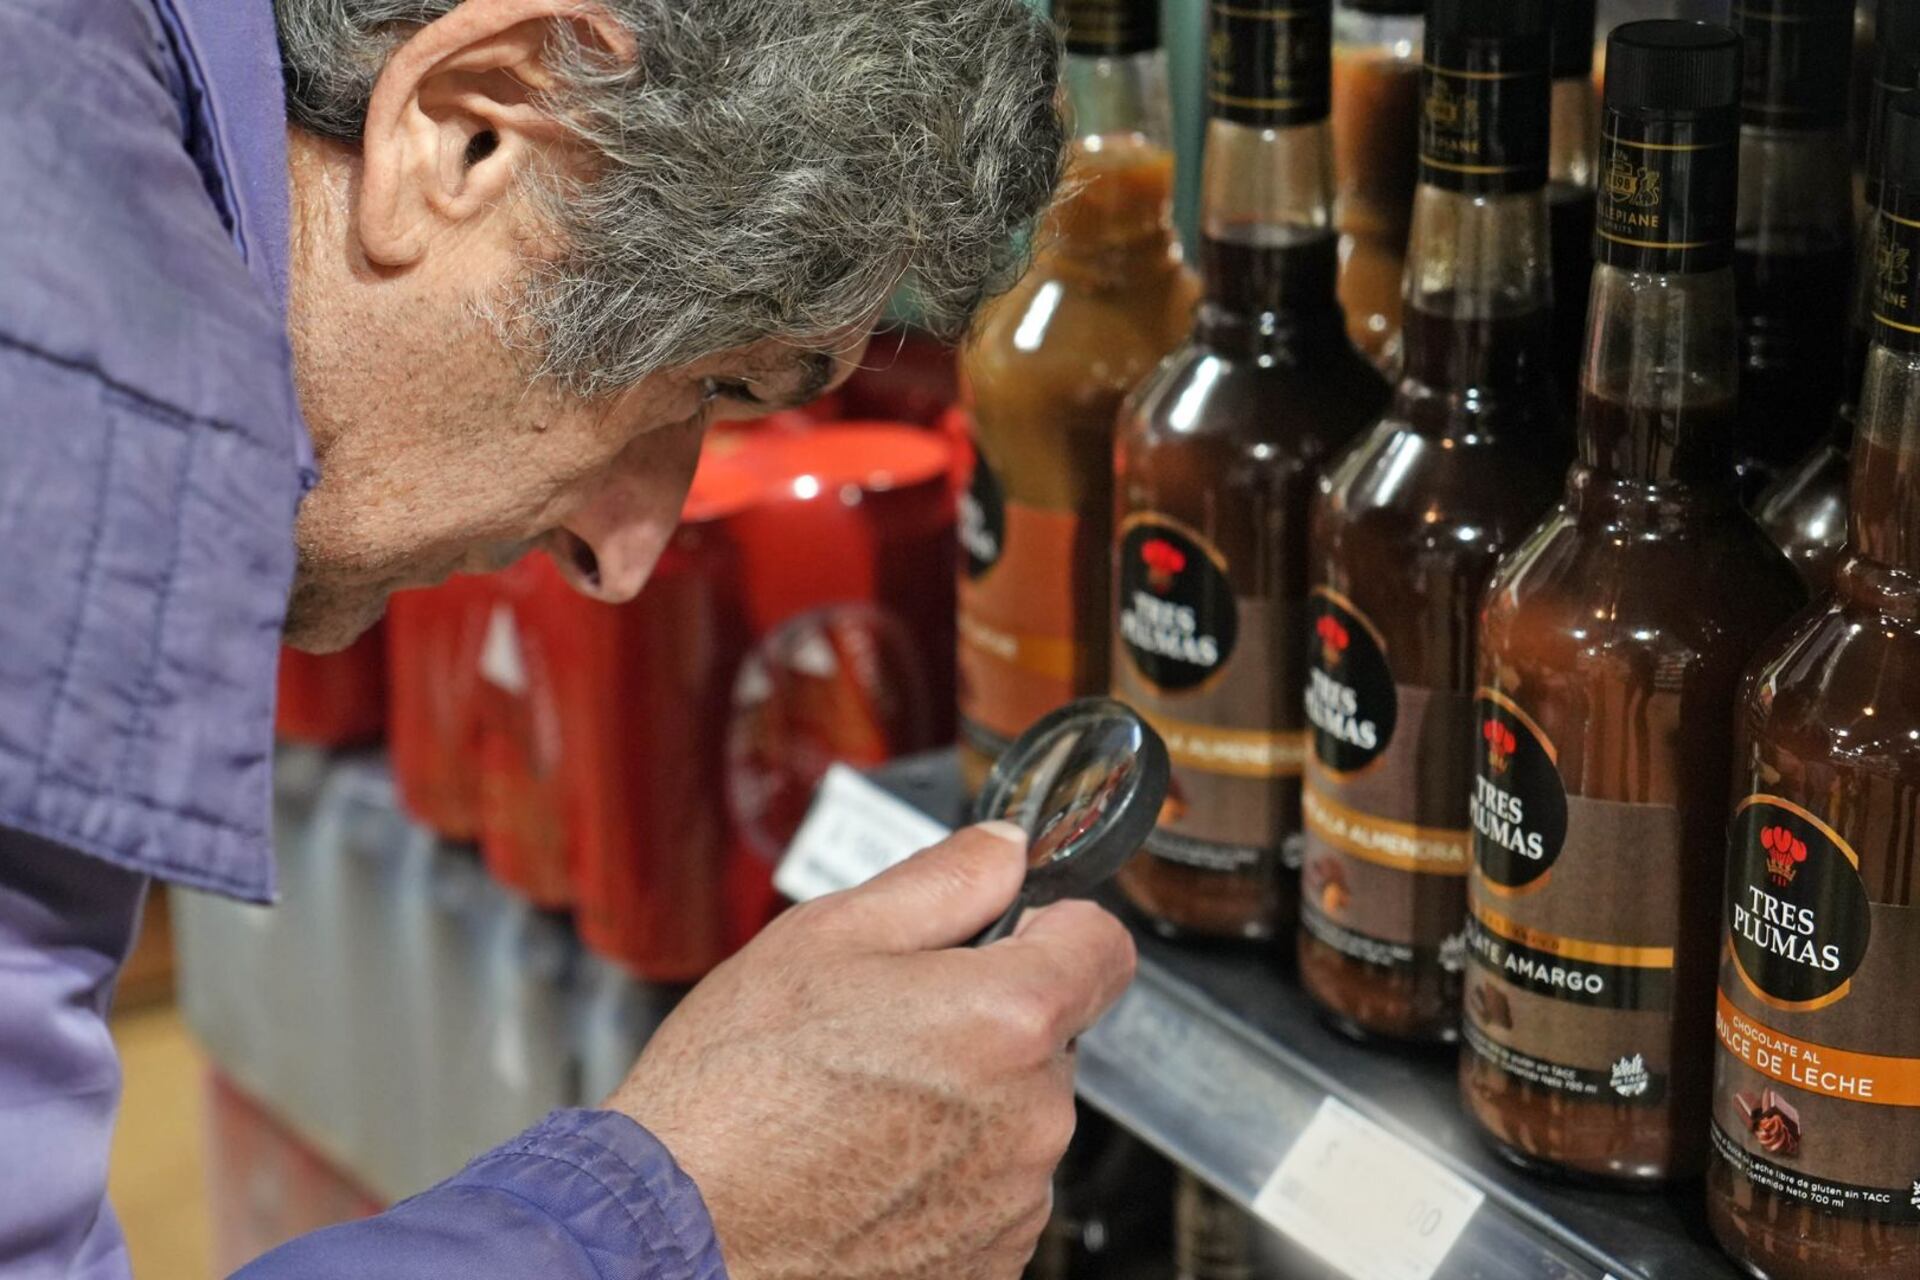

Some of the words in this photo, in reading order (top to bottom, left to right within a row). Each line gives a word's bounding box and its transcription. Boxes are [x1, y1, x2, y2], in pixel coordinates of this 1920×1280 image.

[1133, 591, 1196, 634] TRES
[1311, 667, 1357, 717] TRES
[1477, 773, 1523, 825] TRES
[1749, 885, 1815, 936] TRES
[1733, 902, 1840, 972] PLUMAS
[1504, 952, 1604, 995] AMARGO
[1733, 1016, 1798, 1058] CHOCOLATE
[1802, 1048, 1822, 1066] AL
[1757, 1049, 1782, 1076] DE
[1791, 1062, 1873, 1098] LECHE
[1750, 1160, 1774, 1177] Leche
[1775, 1170, 1795, 1185] libre
[1797, 1178, 1809, 1190] de
[1811, 1182, 1842, 1198] gluten
[1844, 1188, 1859, 1200] sin
[1862, 1191, 1891, 1205] TACC
[1786, 1184, 1808, 1200] Neto
[1810, 1192, 1829, 1206] 700
[1831, 1198, 1844, 1209] ml
